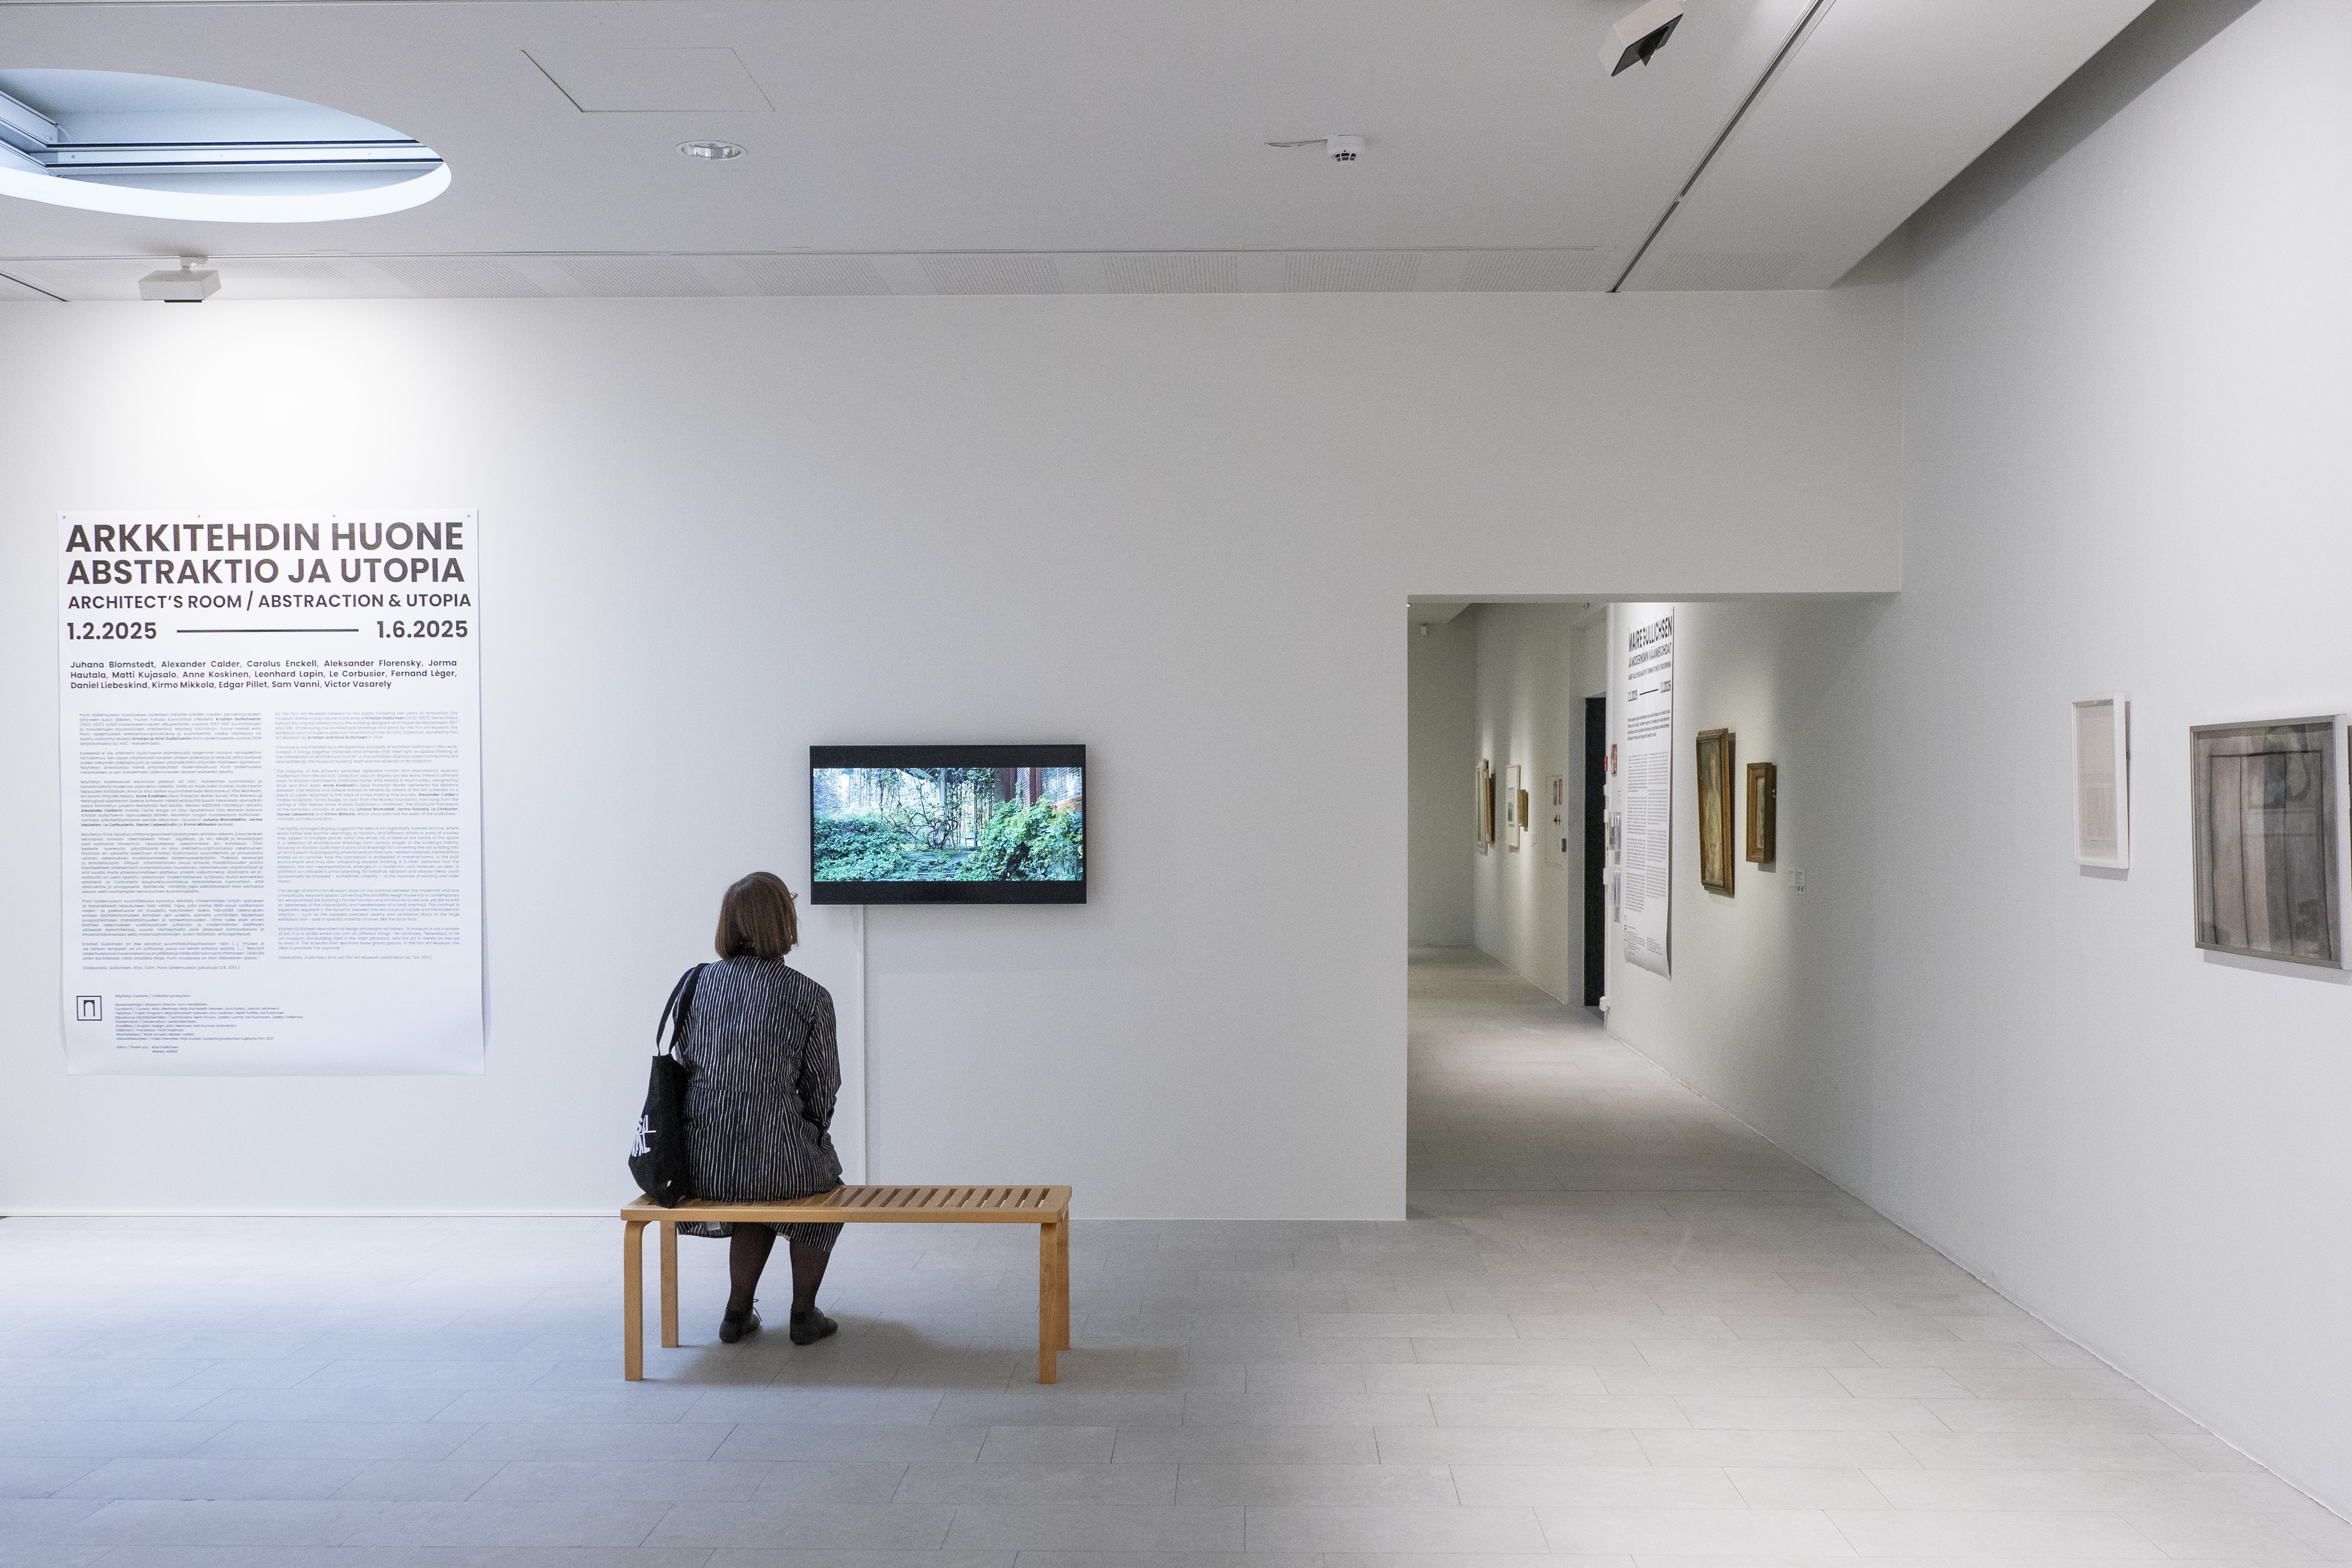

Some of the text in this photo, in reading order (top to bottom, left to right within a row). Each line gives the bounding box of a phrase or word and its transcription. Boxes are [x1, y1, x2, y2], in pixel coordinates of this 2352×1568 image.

[66, 523, 463, 552] ARKKITEHDIN HUONE
[67, 558, 465, 584] ABSTRAKTIO JA UTOPIA
[189, 595, 241, 608] ROOM
[259, 594, 383, 607] ABSTRACTION
[389, 594, 401, 607] &
[407, 594, 471, 607] UTOPIA
[67, 620, 467, 639] 1.2.2025 1.6.2025
[1629, 616, 1672, 652] MAIRE GULLICHSEN
[108, 661, 156, 669] Blomstedt,
[211, 660, 242, 669] Calder,
[285, 660, 319, 668] Enckell,
[379, 660, 424, 669] Florensky,
[71, 671, 109, 680] Hautala,
[138, 671, 178, 680] Kujasalo,
[209, 671, 251, 679] Koskinen,
[299, 670, 325, 680] Lapin,
[342, 670, 387, 678] Corbusier,
[430, 670, 457, 679] Léger,
[101, 682, 150, 690] Liebeskind,
[180, 681, 217, 690] Mikkola,
[219, 681, 243, 690] Edgar
[246, 681, 270, 689] Pillet,
[294, 681, 322, 689] Vanni,
[353, 680, 392, 690] Vasarely
